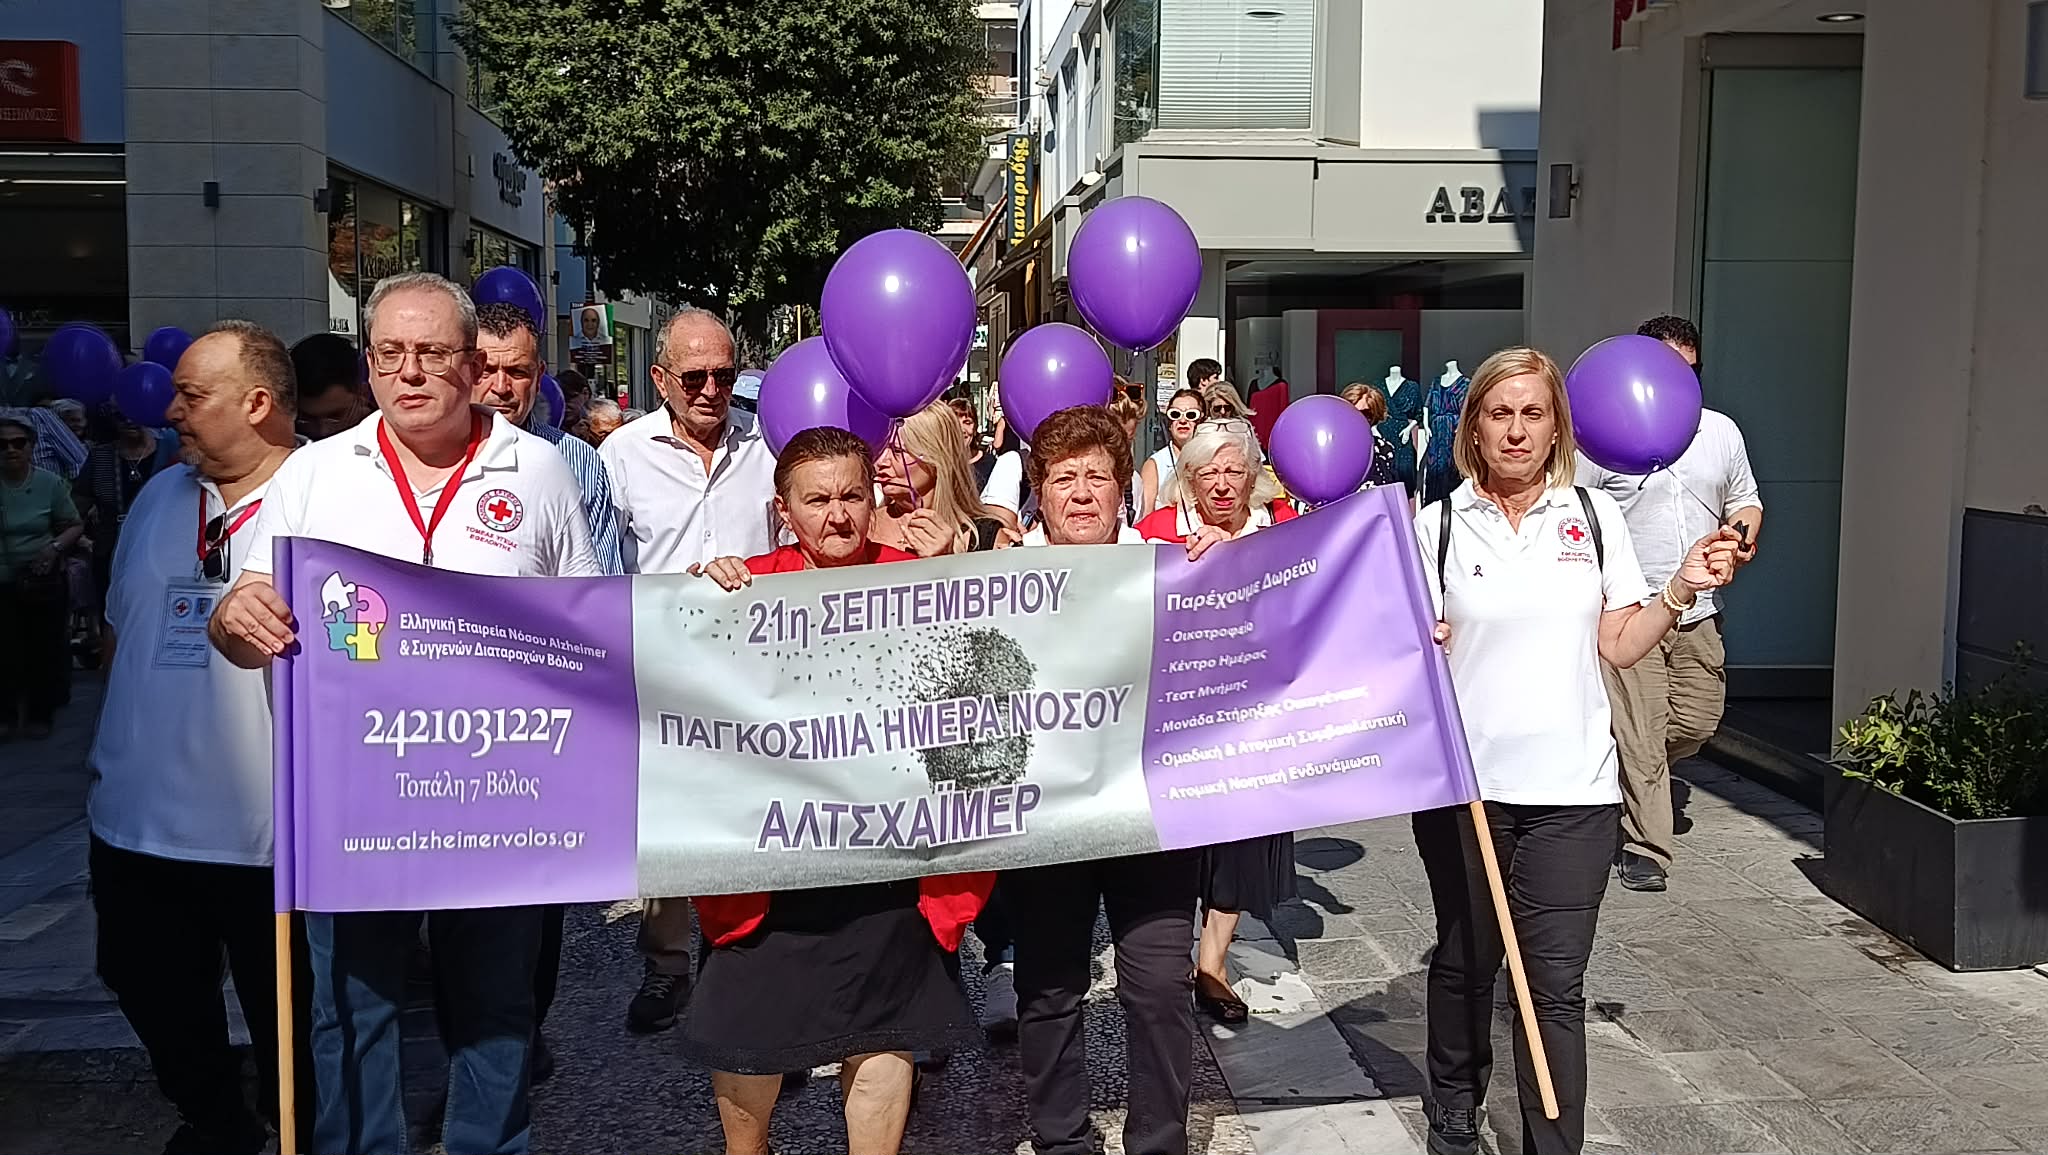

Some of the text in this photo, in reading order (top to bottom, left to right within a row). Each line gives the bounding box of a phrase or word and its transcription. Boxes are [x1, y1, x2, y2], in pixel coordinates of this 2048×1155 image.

[1167, 558, 1318, 611] Παρέχουμε Δωρεάν
[747, 570, 1070, 647] 21η ΣΕΠΤΕΜΒΡΙΟΥ
[400, 613, 607, 659] Ελληνική Εταιρεία Νόσου Alzheimer
[400, 639, 584, 671] & Συγγενών Διαταραχών Βόλου
[1218, 649, 1268, 667] Ημέρας
[1197, 680, 1249, 698] Μνήμης
[363, 707, 573, 758] 2421031227
[659, 684, 1134, 760] ΠΑΓΚΟΣΜΙΑ ΗΜΕΡΑ ΝΟΣΟΥ
[1161, 714, 1214, 734] Μονάδα
[1287, 754, 1382, 780] Ενδυνάμωση
[395, 769, 540, 804] Τοπάλη 7 Βόλος
[756, 781, 1041, 852] ΑΛΤΣΧΑΪΜΕΡ
[343, 826, 586, 852] www.alzheimervolos.gr
